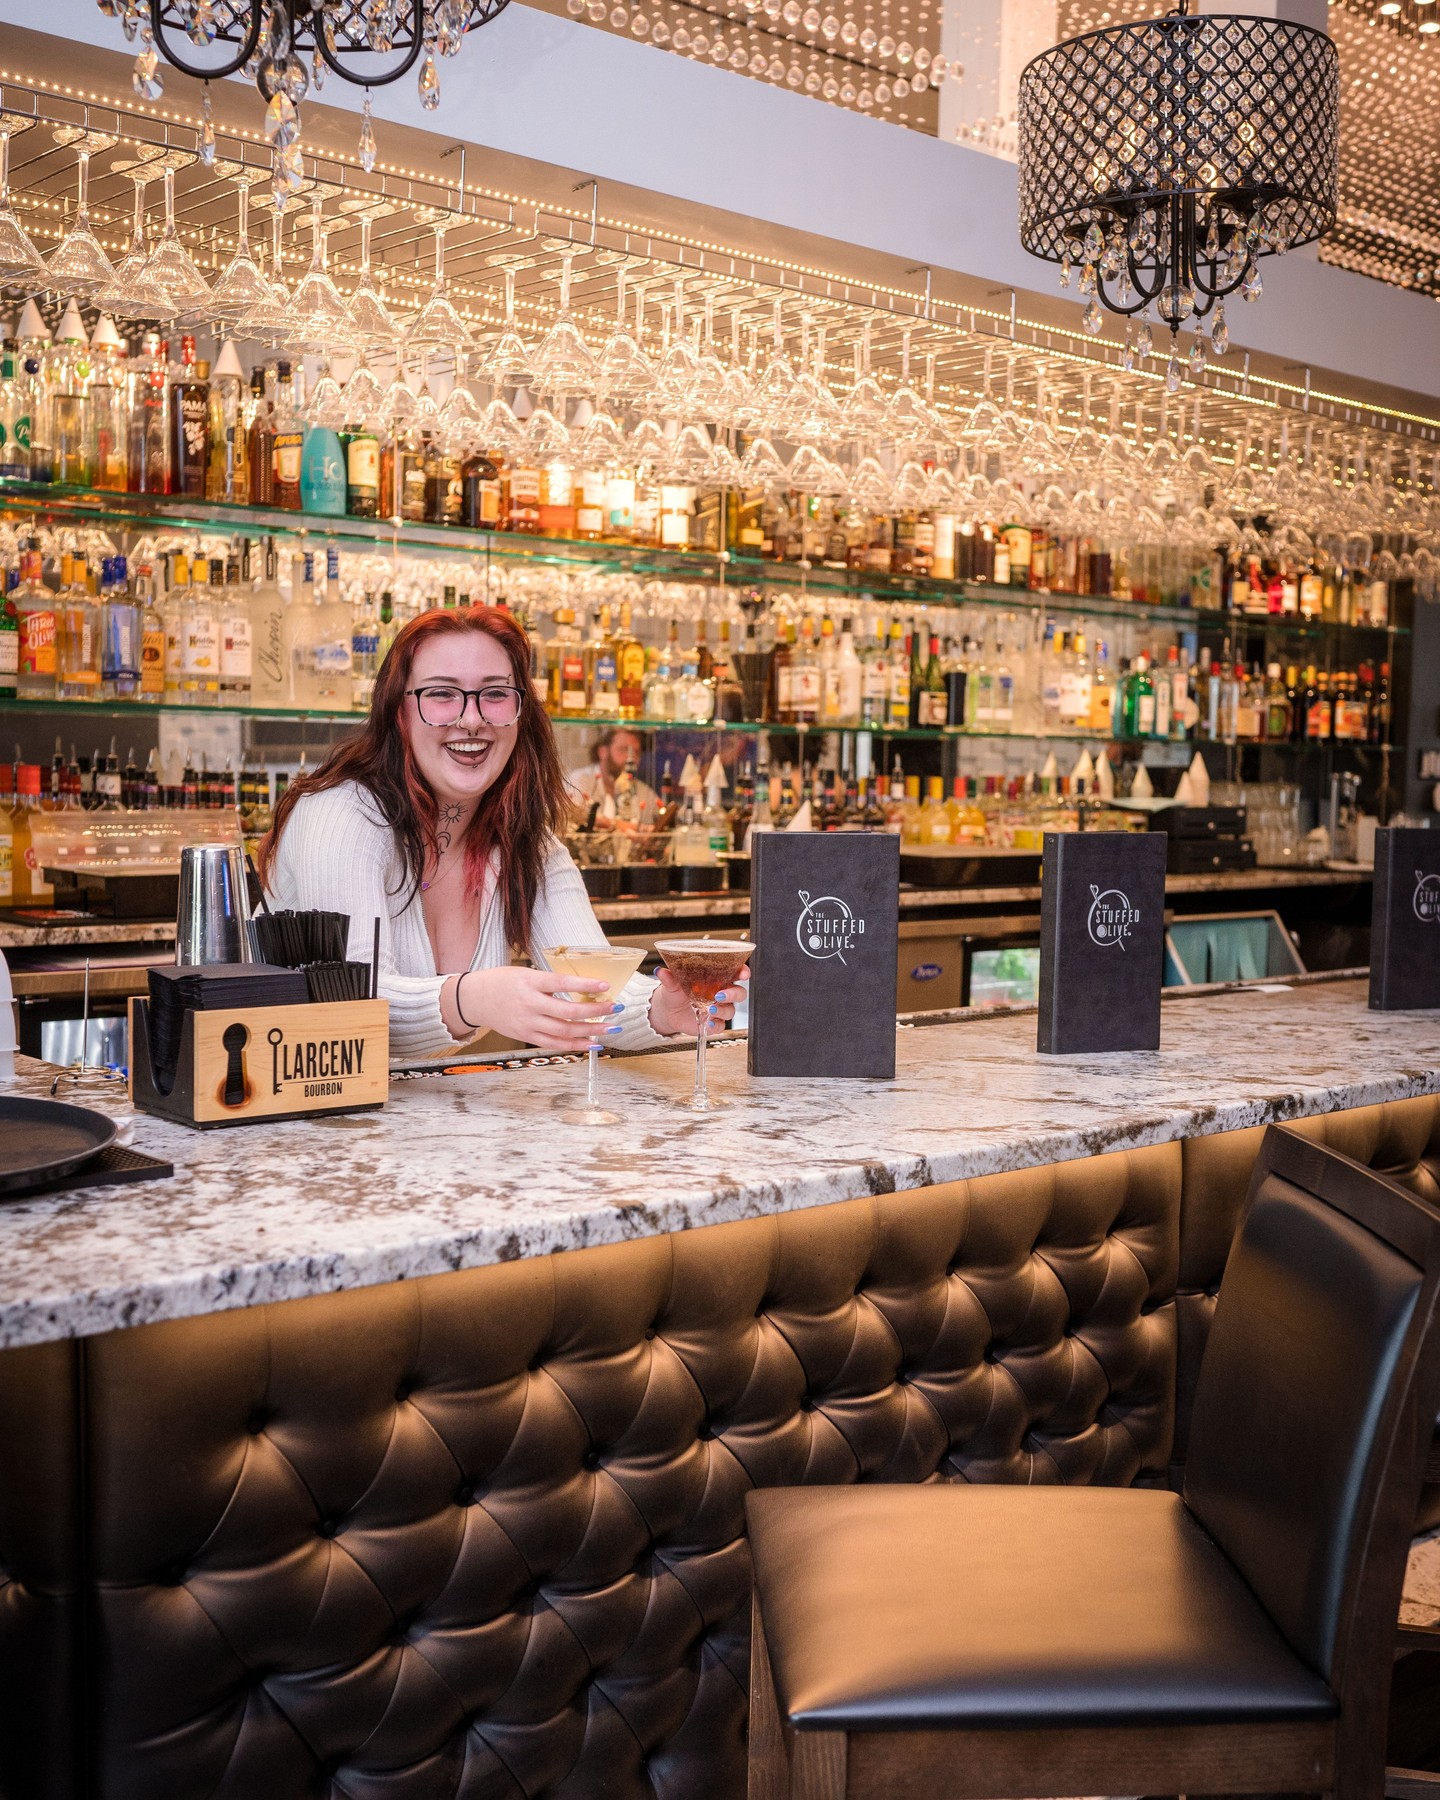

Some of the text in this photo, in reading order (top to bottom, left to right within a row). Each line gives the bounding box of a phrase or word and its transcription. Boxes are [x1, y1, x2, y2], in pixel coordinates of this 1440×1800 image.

[257, 607, 283, 683] Chopin
[1095, 909, 1140, 924] STUFFED
[807, 919, 865, 934] STUFFED
[283, 1038, 365, 1081] LARCENY
[304, 1081, 343, 1098] BOURBON
